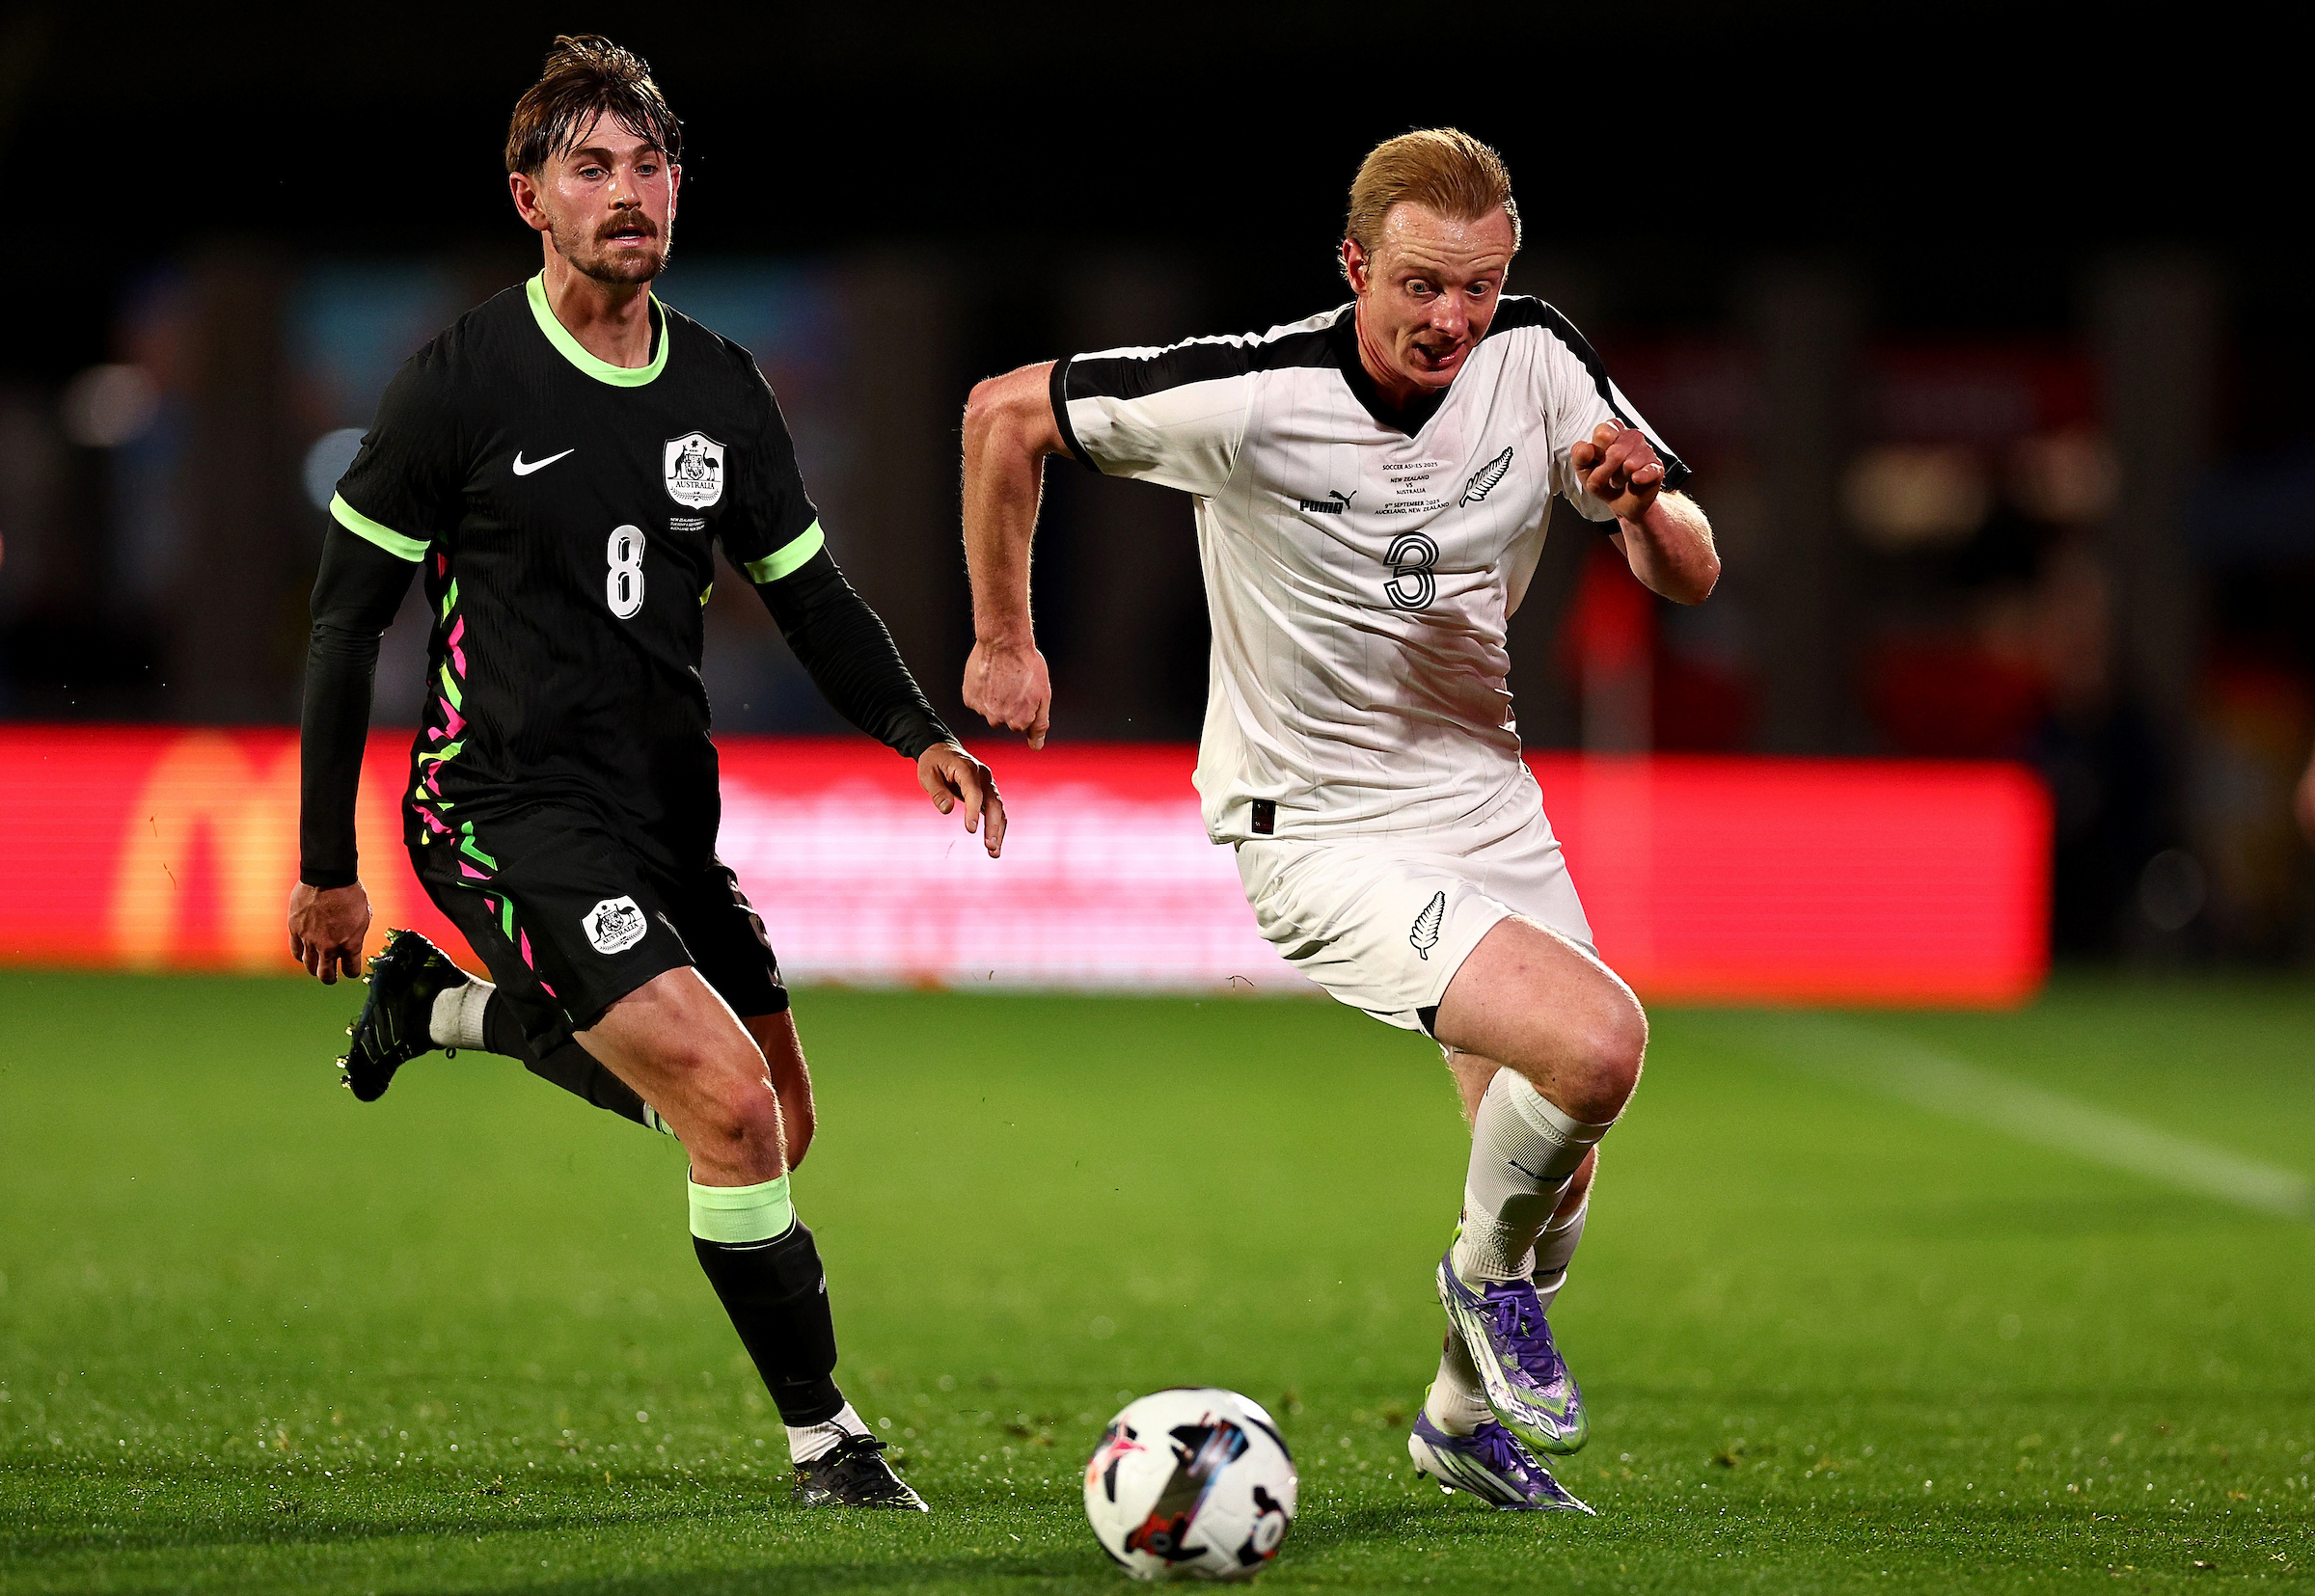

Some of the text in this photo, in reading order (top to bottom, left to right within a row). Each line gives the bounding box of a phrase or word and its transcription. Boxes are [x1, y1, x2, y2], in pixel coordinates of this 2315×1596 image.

[676, 480, 715, 489] AUSTRALIA
[1299, 499, 1344, 514] PUMA
[1423, 501, 1450, 512] ZEALAND
[607, 524, 646, 620] 8
[1382, 531, 1440, 610] 3
[602, 923, 639, 945] AUSTRALIA
